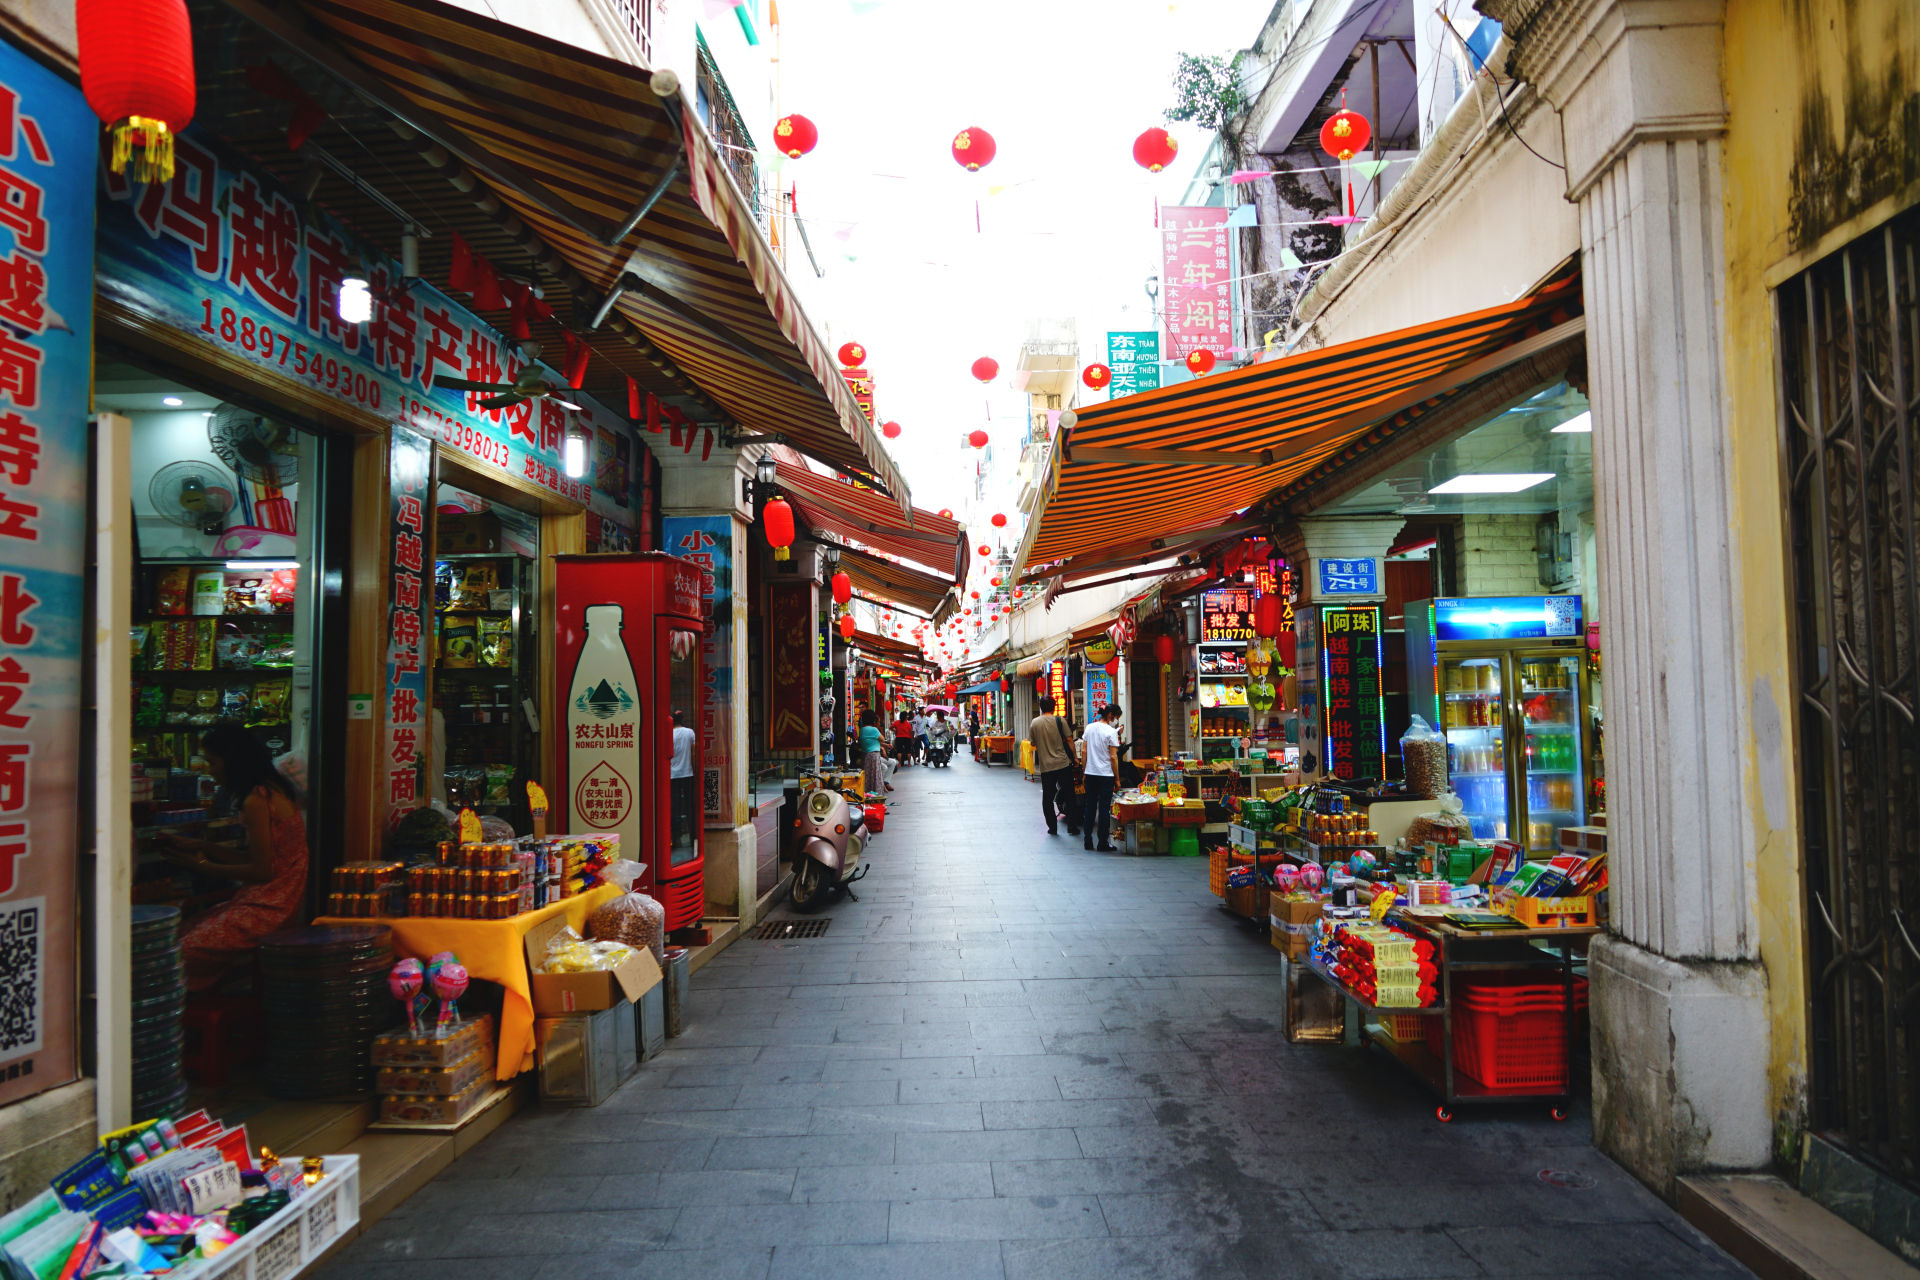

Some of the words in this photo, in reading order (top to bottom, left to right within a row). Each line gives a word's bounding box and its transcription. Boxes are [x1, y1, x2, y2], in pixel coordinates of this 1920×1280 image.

[1165, 220, 1178, 264] 越南特产
[1214, 221, 1227, 270] 各类佛珠
[1181, 219, 1215, 330] 兰轩阁
[97, 127, 594, 473] 冯越南特产批发商行
[1167, 277, 1180, 333] 红木工艺品
[1217, 285, 1229, 333] 香水副食
[200, 297, 381, 409] 18897549300
[1175, 343, 1224, 352] 139776978
[1181, 335, 1217, 344] 零售批发
[398, 394, 510, 468] 18776398013
[1327, 563, 1368, 574] 建设街
[1329, 577, 1369, 590] 2-1号
[1210, 613, 1240, 628] 批发
[1091, 681, 1107, 724] 越南特
[1328, 636, 1354, 780] 越南特产批发商
[1356, 636, 1381, 779] 厂家直销只做正
[575, 722, 634, 739] 农夫山泉
[575, 740, 604, 749] NONGFU
[606, 740, 634, 749] SPRING
[585, 788, 623, 799] 农夫山泉
[589, 777, 618, 788] 每一滴
[585, 799, 623, 809] 都有优质
[589, 809, 619, 820] 的水源
